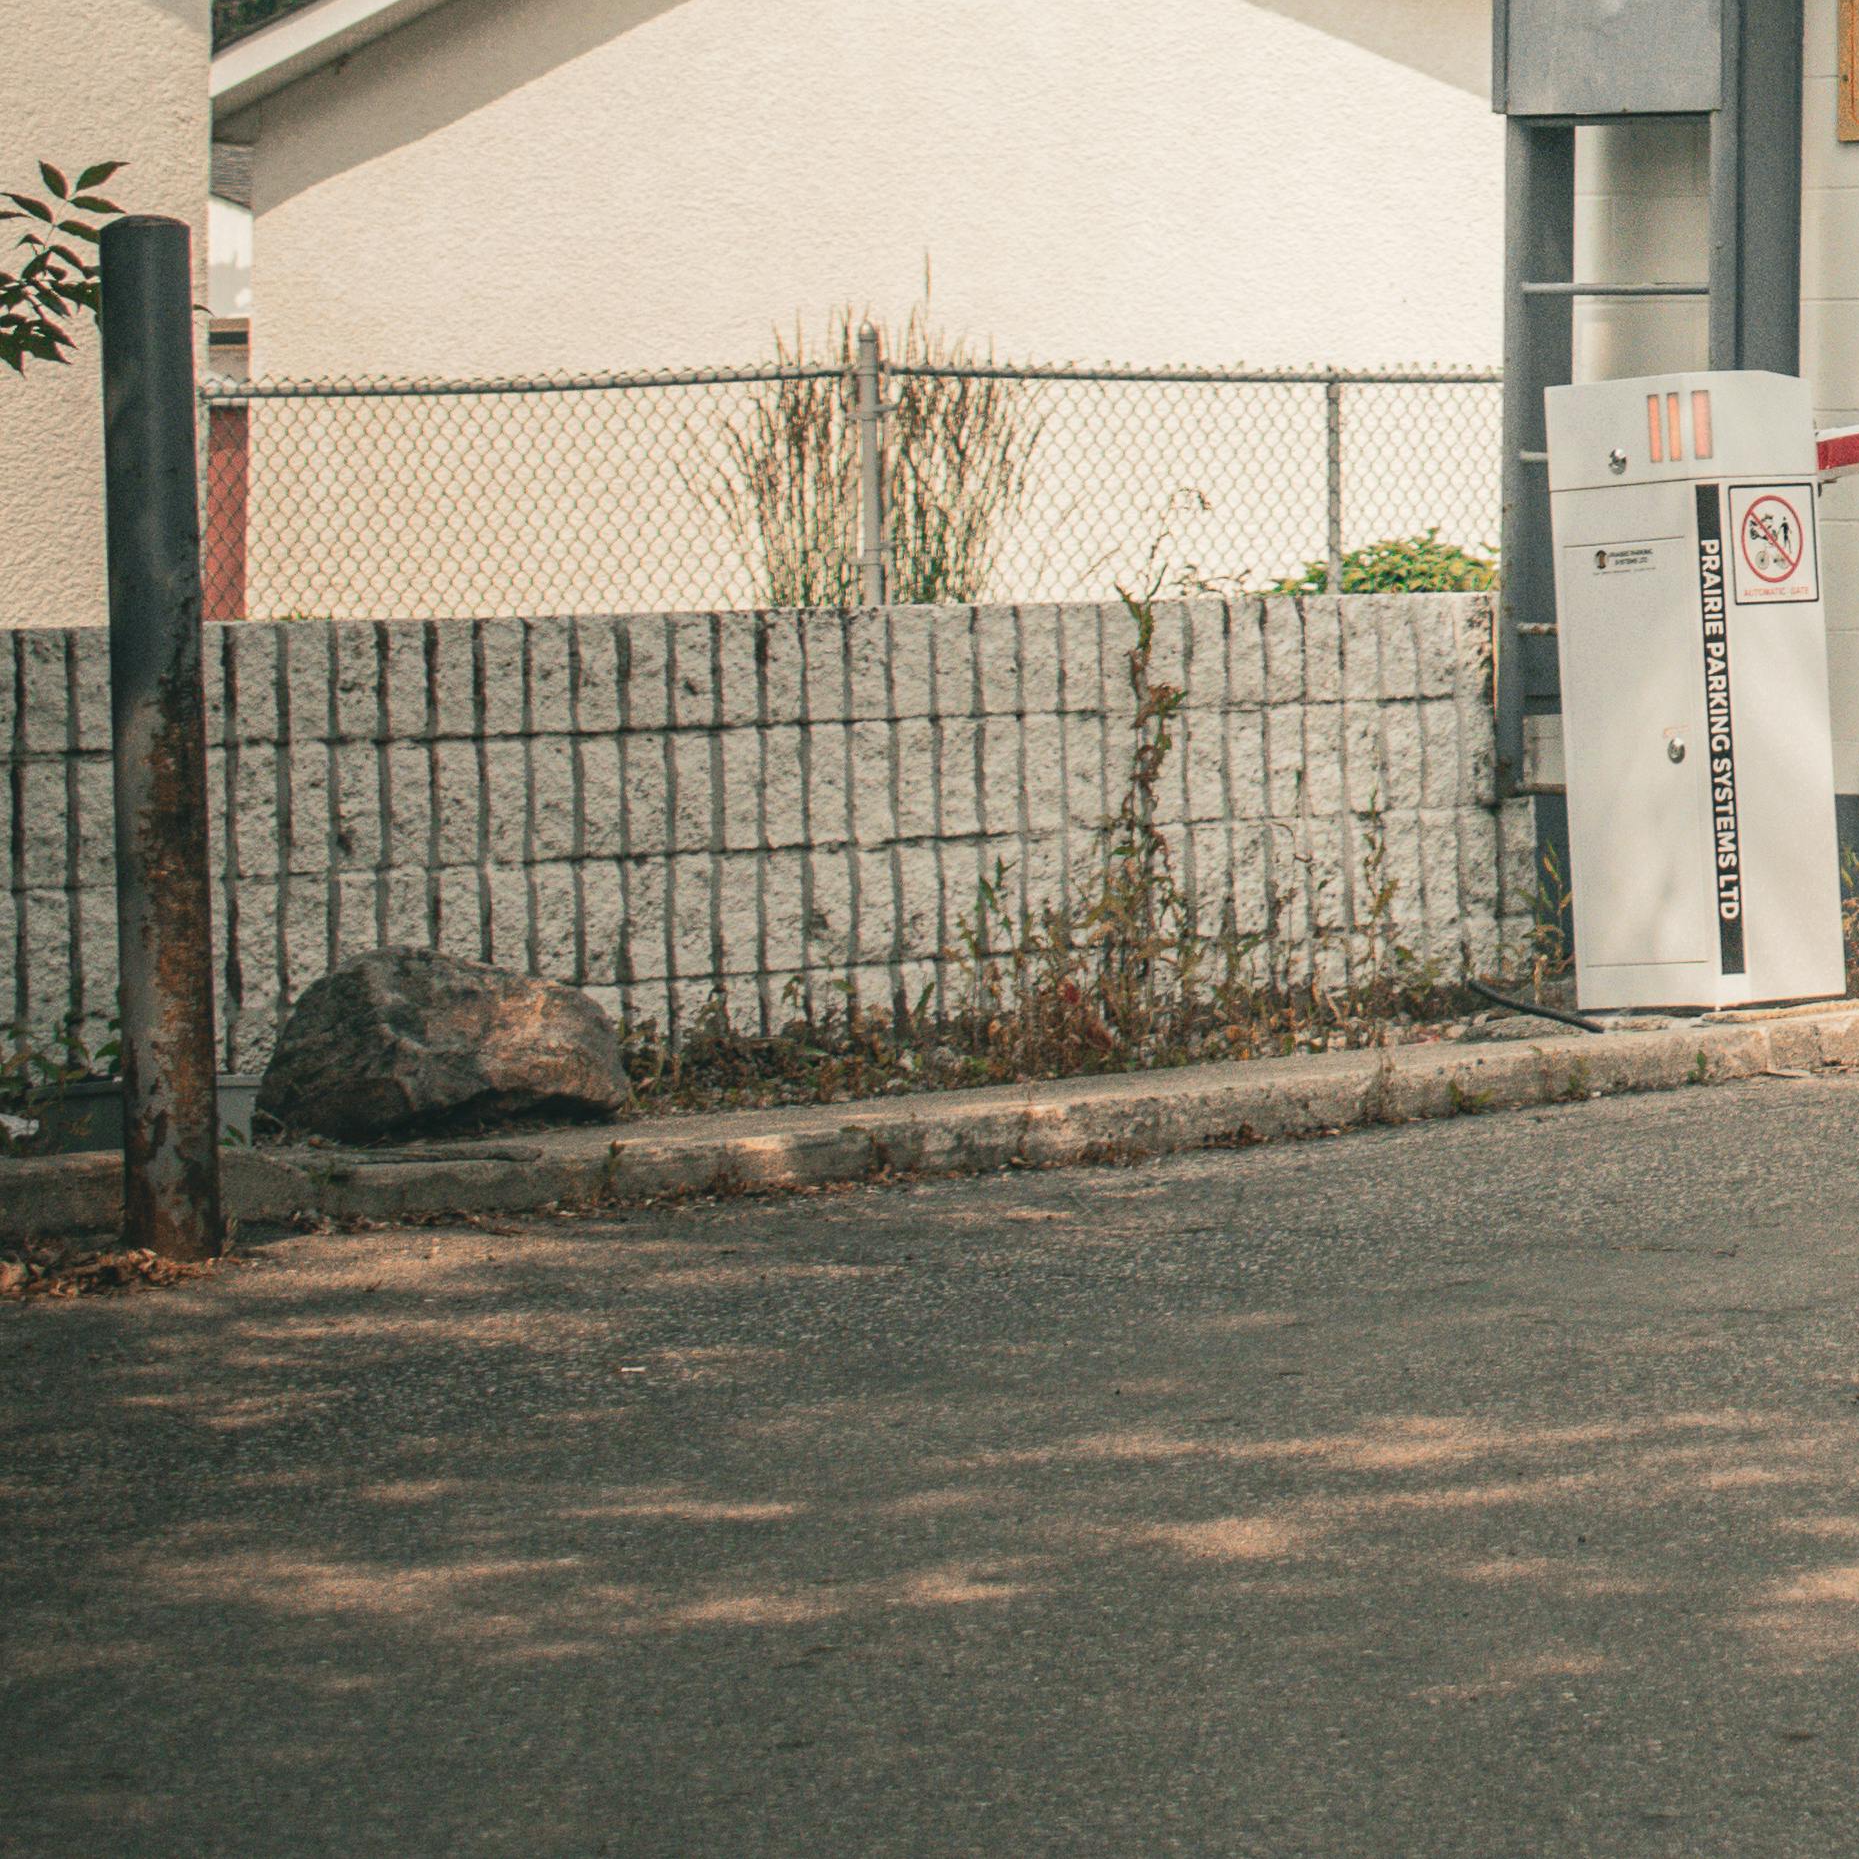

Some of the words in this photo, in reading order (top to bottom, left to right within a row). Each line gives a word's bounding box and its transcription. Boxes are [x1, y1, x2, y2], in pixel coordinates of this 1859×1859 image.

[1701, 539, 1724, 636] PRAIRIE
[1707, 642, 1730, 752] PARKING
[1713, 758, 1736, 868] SYSTEMS
[1720, 875, 1740, 920] LTD
